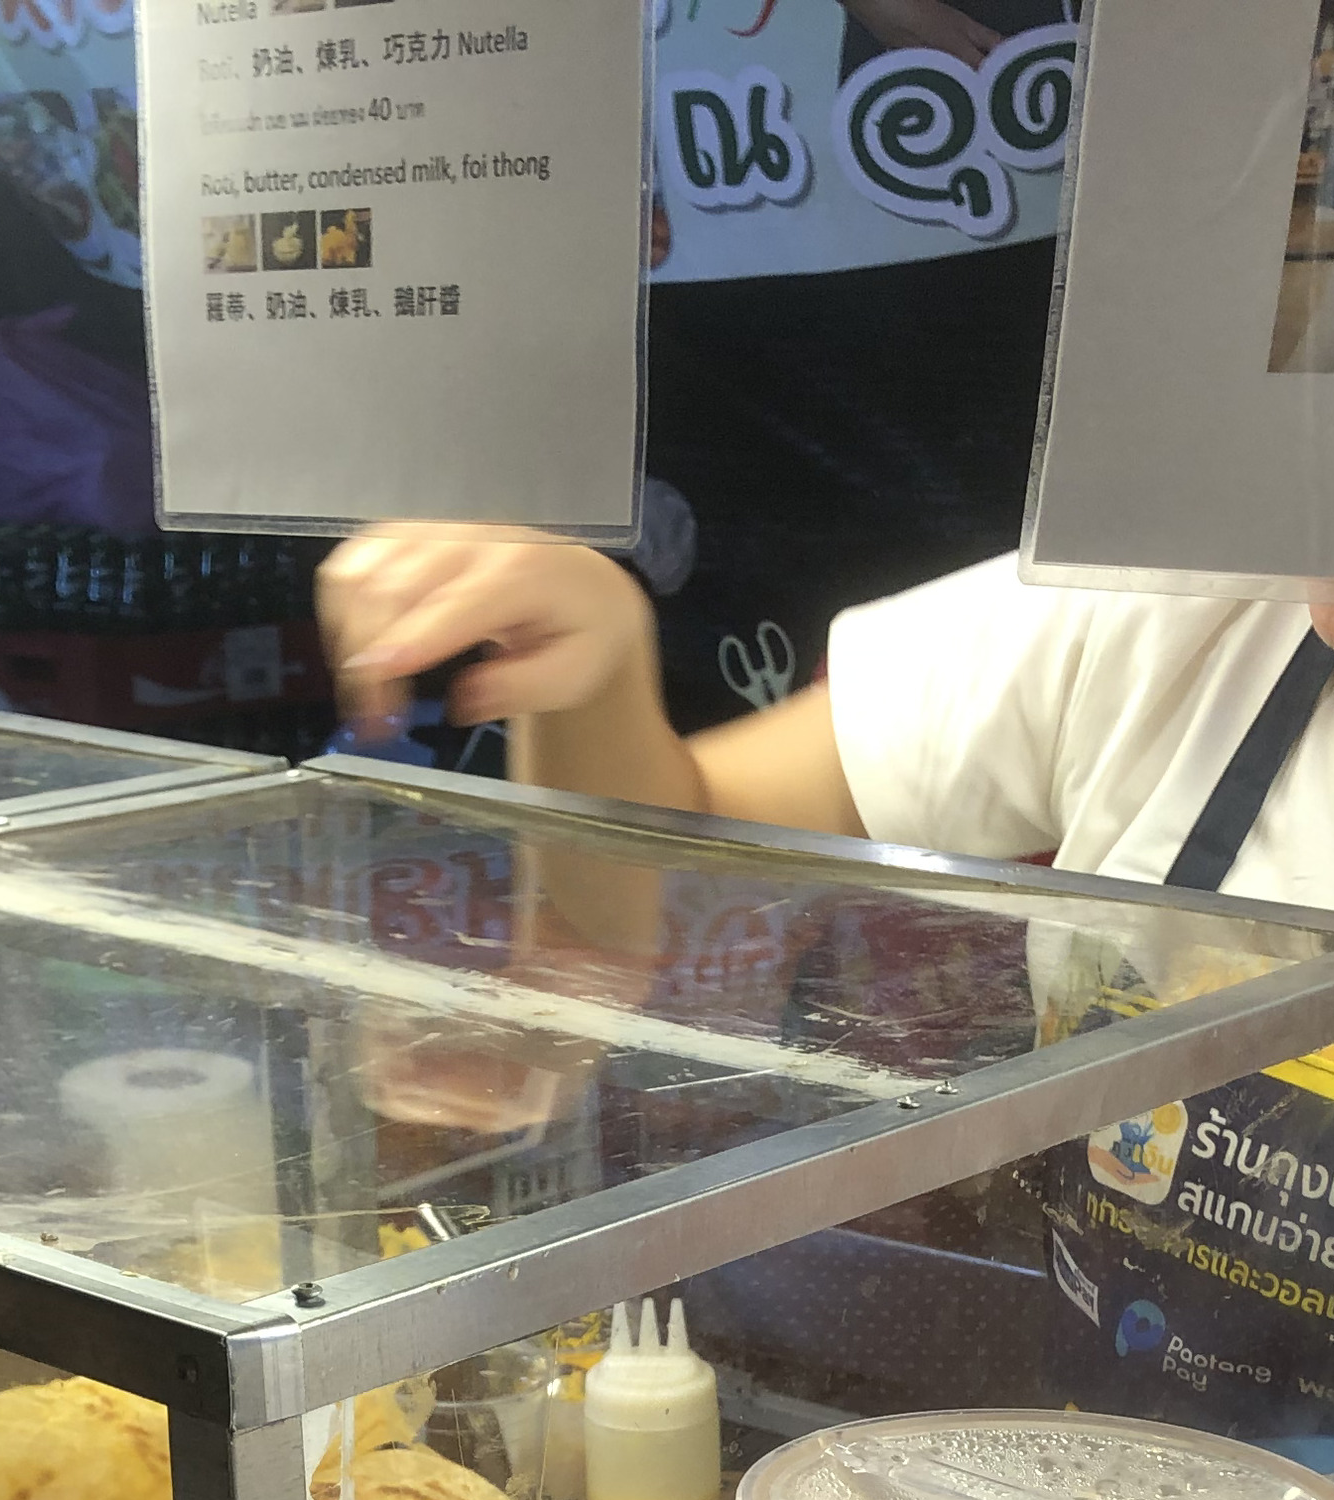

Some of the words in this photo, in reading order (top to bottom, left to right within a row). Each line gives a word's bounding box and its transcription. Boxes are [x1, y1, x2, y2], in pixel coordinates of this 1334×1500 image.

[457, 25, 530, 57] Nutella
[368, 97, 392, 121] 40
[243, 167, 305, 194] butter,
[308, 159, 407, 190] condensed
[411, 155, 458, 184] milk,
[462, 153, 488, 179] foi
[492, 151, 551, 181] thong
[1162, 1354, 1208, 1393] Pay
[1167, 1335, 1273, 1384] Paotang
